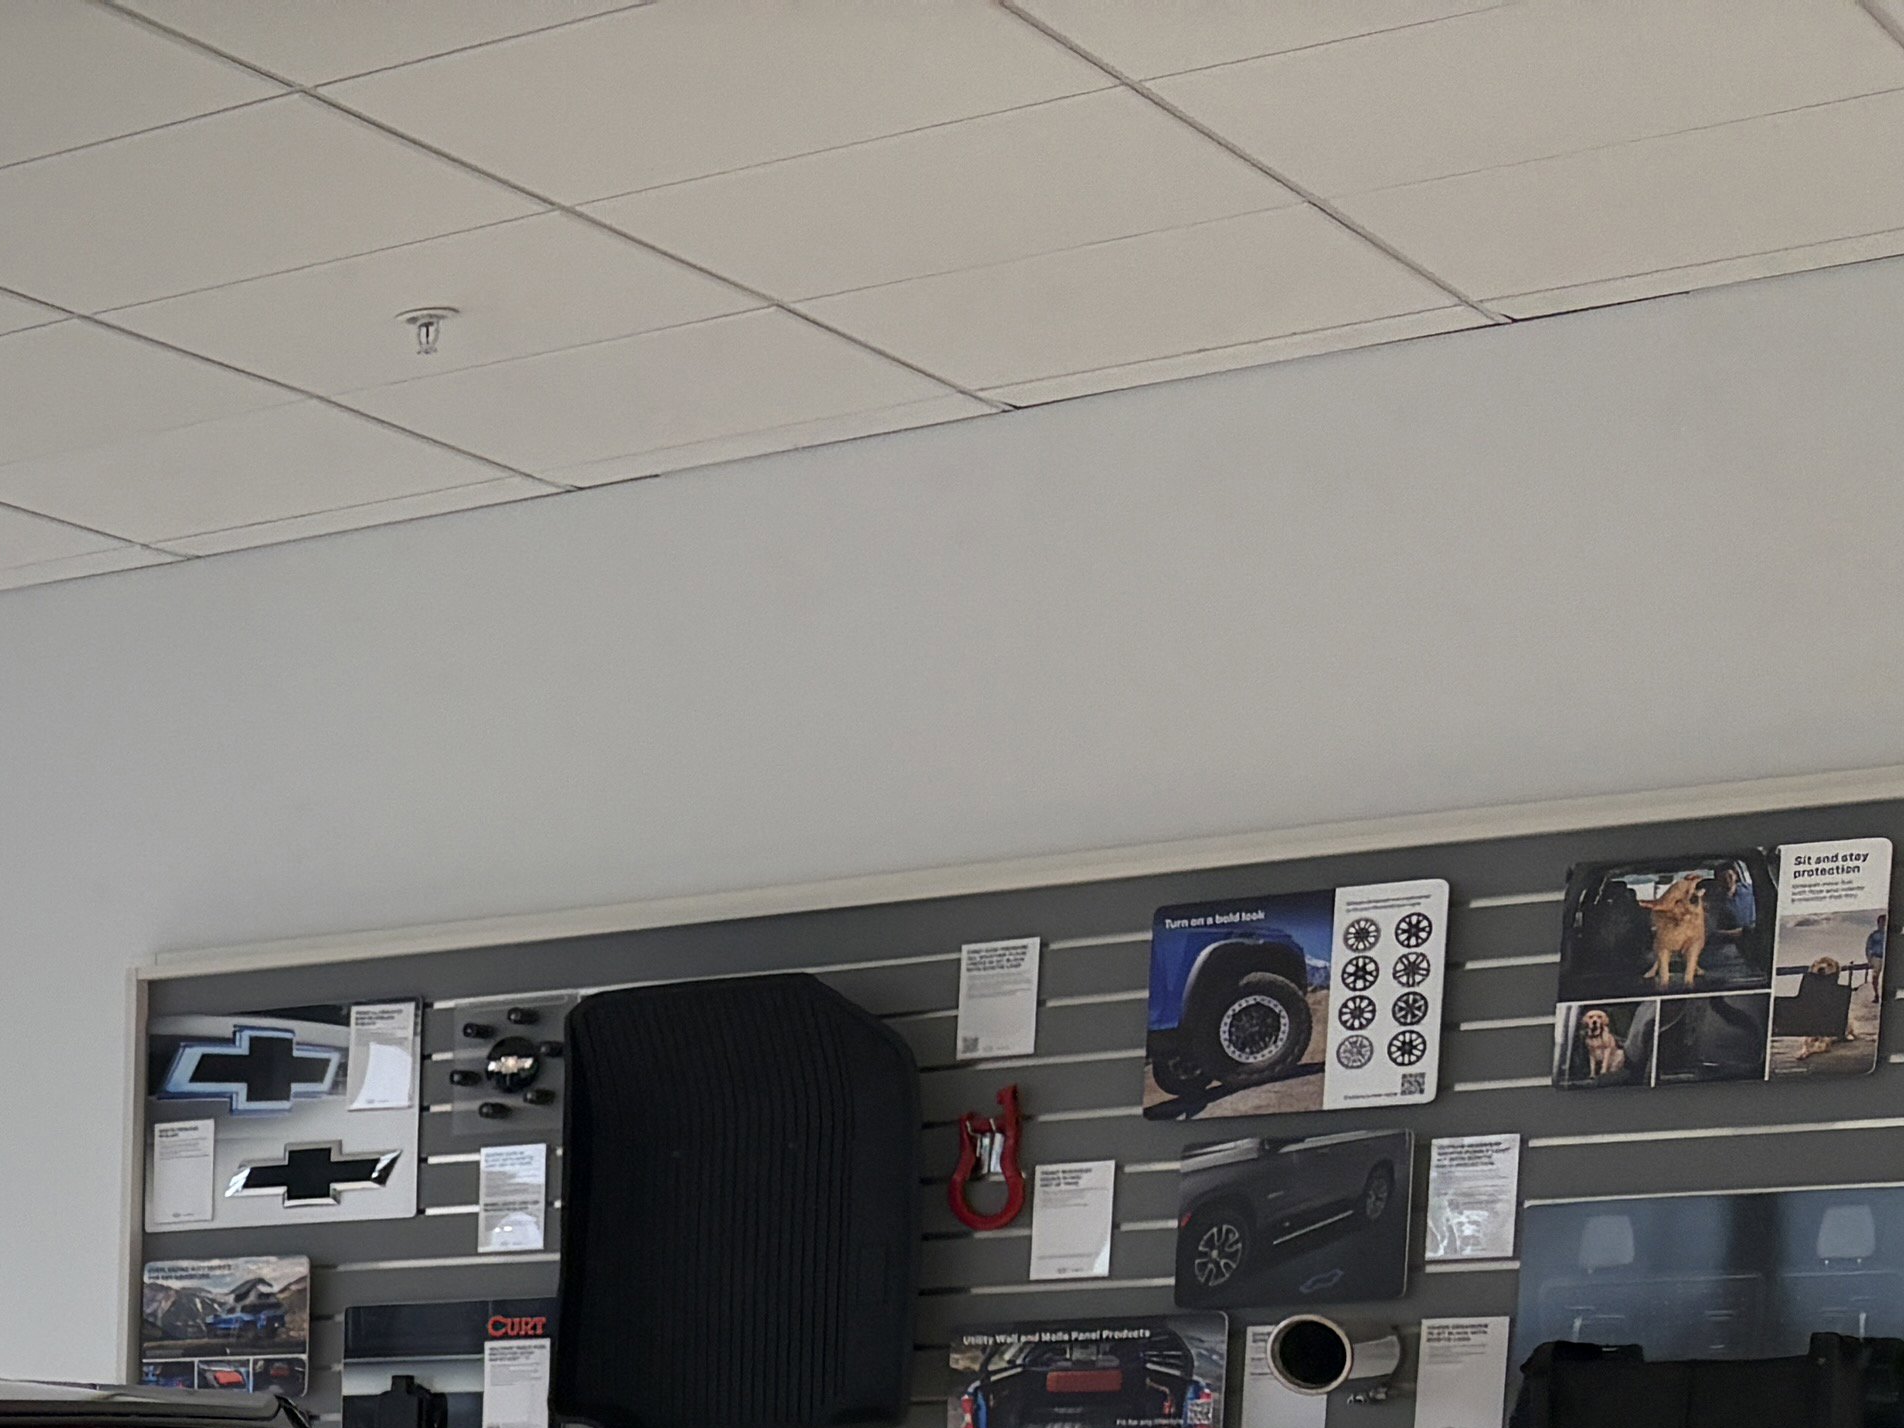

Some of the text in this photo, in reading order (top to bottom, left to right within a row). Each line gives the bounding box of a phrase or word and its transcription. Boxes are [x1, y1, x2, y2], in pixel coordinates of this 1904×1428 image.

[1794, 851, 1869, 866] Sit and stay
[1793, 864, 1861, 879] protection
[1165, 917, 1189, 930] Turn
[1190, 917, 1204, 928] on
[1216, 912, 1239, 925] bold
[1241, 909, 1265, 923] look
[487, 1314, 547, 1338] CURT
[996, 1332, 1018, 1344] Wall
[1071, 1329, 1100, 1341] Panel
[1103, 1328, 1151, 1340] Products
